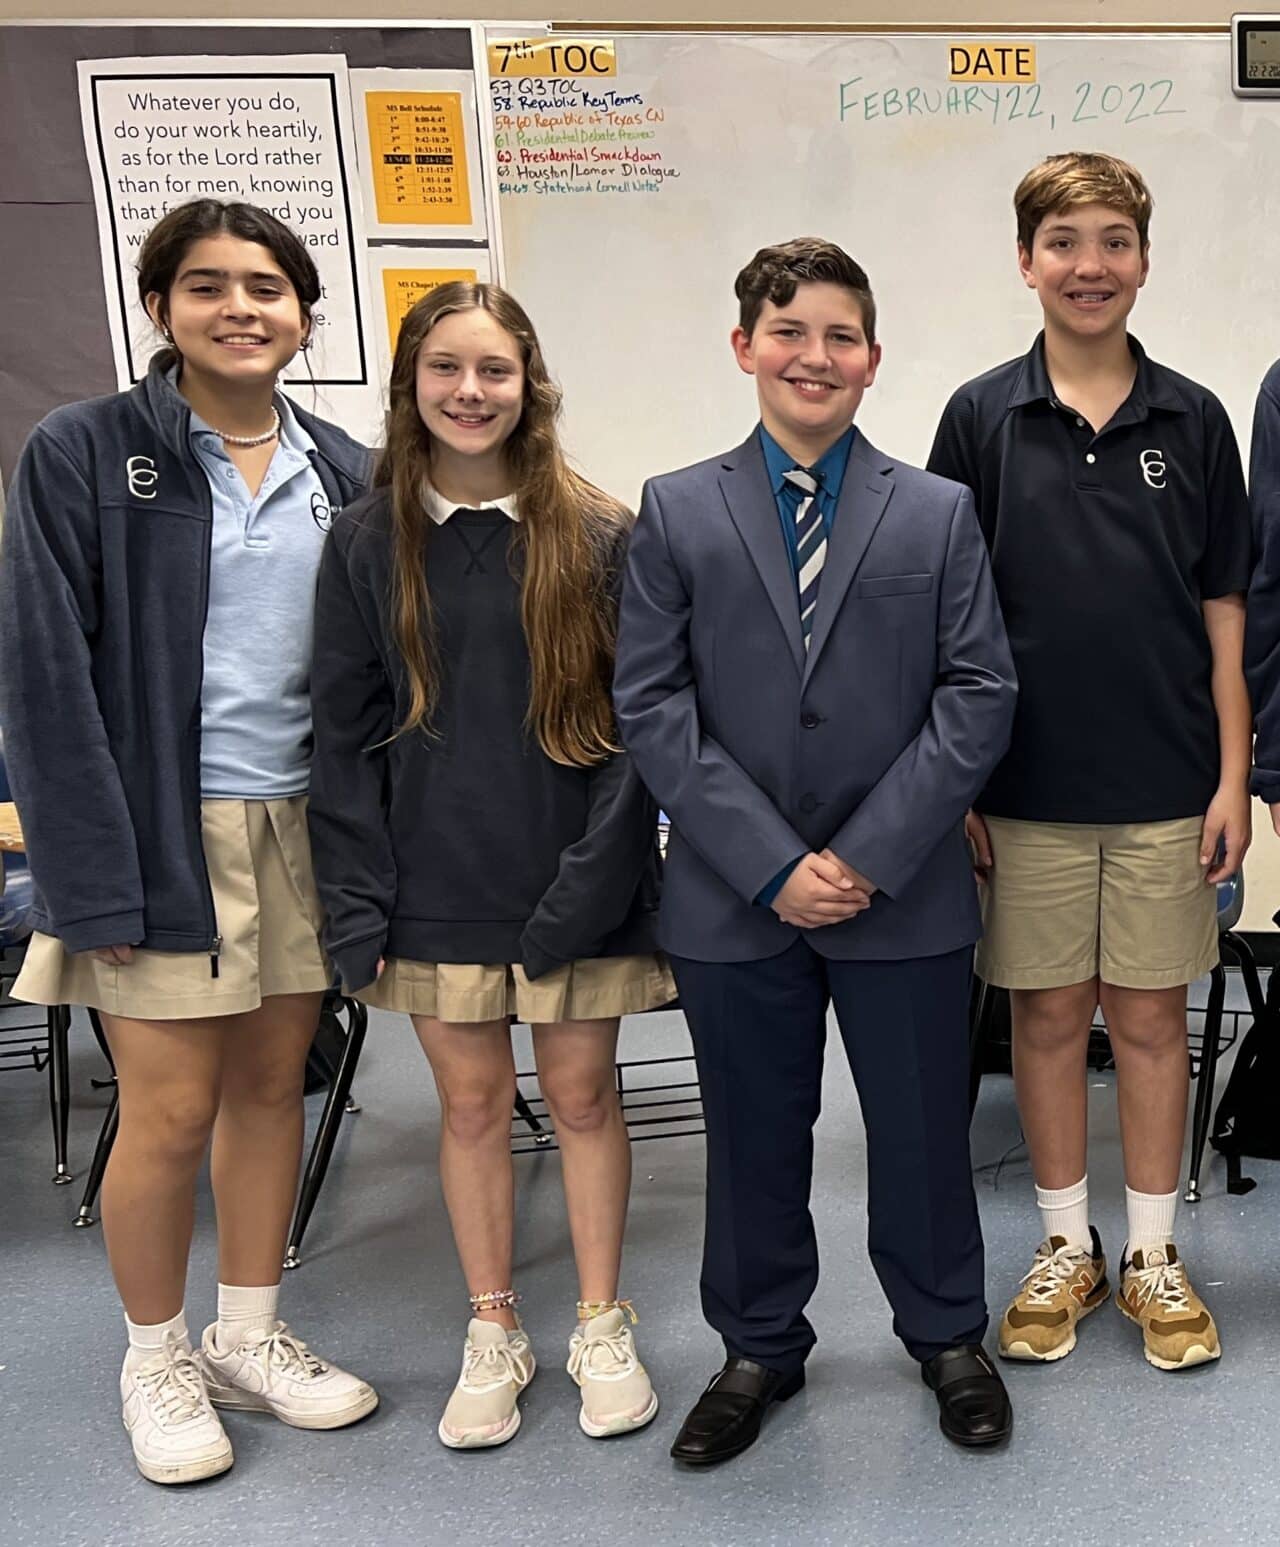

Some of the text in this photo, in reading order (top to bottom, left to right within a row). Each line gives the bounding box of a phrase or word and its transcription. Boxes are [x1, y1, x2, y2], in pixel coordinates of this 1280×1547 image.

[495, 41, 610, 73] 7th TOC
[950, 47, 1031, 76] DATE
[128, 91, 301, 115] Whatever you do,
[520, 95, 578, 112] Republic
[1071, 80, 1188, 124] 2022
[114, 117, 323, 143] do your work heartily,
[606, 112, 642, 126] Texas
[121, 146, 323, 166] as for the Lord rather
[519, 148, 589, 164] Presidential
[590, 146, 662, 163] Smackdown
[118, 174, 334, 198] than for men, knowing
[120, 201, 157, 220] that
[296, 207, 333, 225] you
